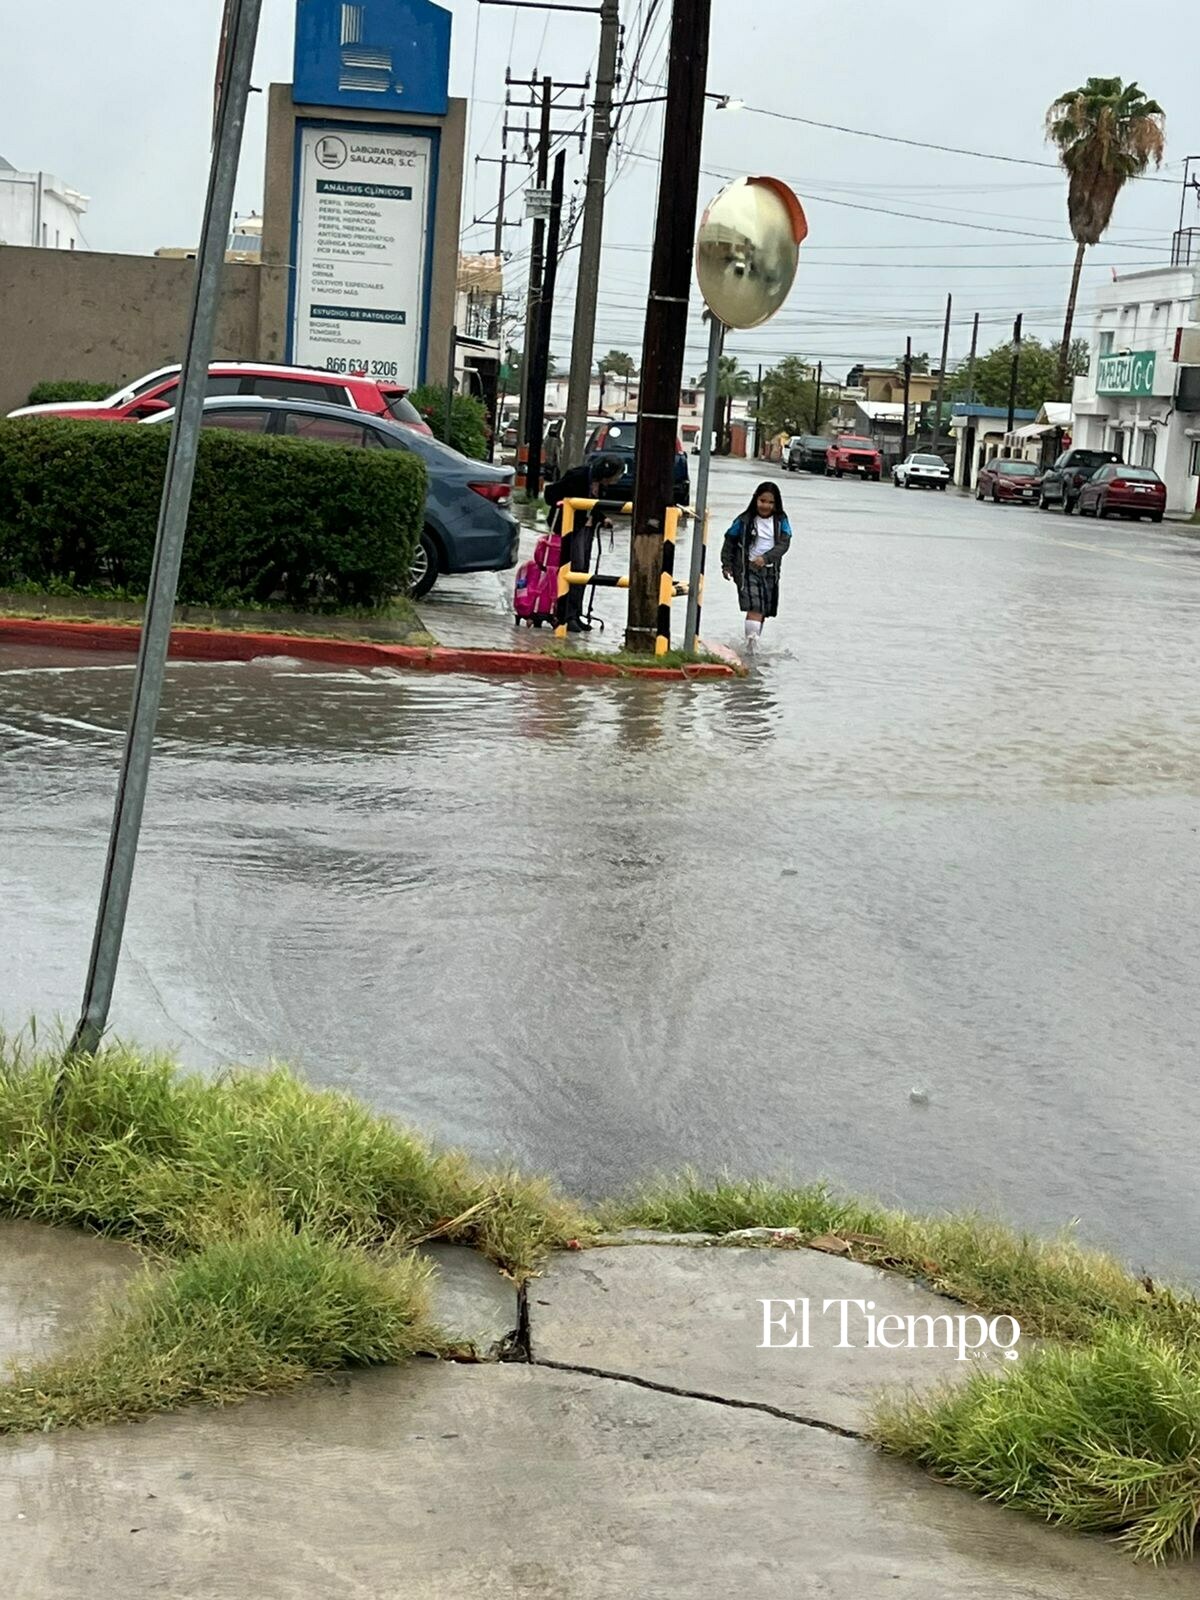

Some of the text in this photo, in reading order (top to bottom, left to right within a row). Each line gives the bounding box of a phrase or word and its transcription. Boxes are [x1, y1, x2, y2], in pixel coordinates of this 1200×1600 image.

[350, 145, 416, 157] LABORATORIOS
[350, 154, 416, 168] SALAZAR, S.C.
[319, 199, 342, 207] PERFIL
[319, 207, 342, 215] PERFIL
[318, 215, 341, 223] PERFIL
[318, 223, 340, 231] PERFIL
[312, 279, 343, 287] CULTIVOS
[312, 308, 348, 318] ESTUDIOS
[326, 357, 398, 377] 866 634 3206
